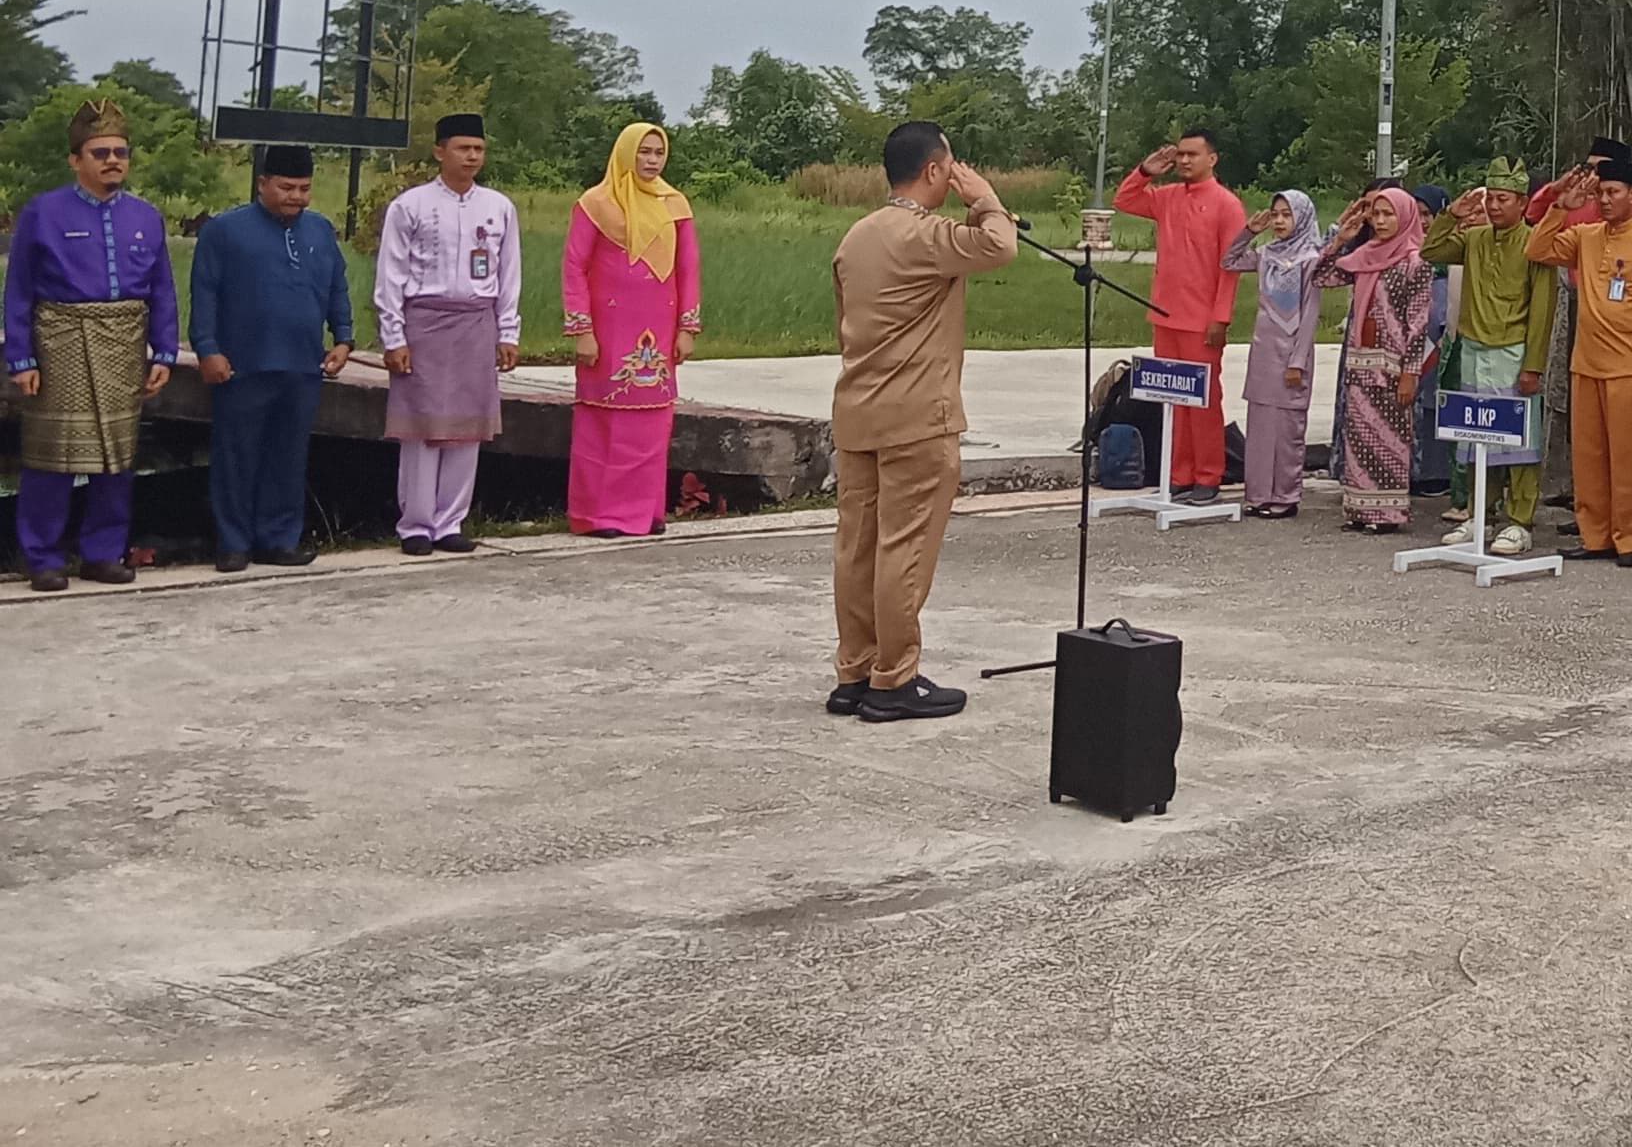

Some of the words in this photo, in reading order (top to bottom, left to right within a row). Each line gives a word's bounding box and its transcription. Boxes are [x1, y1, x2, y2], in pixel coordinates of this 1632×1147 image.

[1140, 371, 1197, 393] SEKRETARIAT
[1464, 406, 1476, 427] B.
[1477, 407, 1497, 428] IKP
